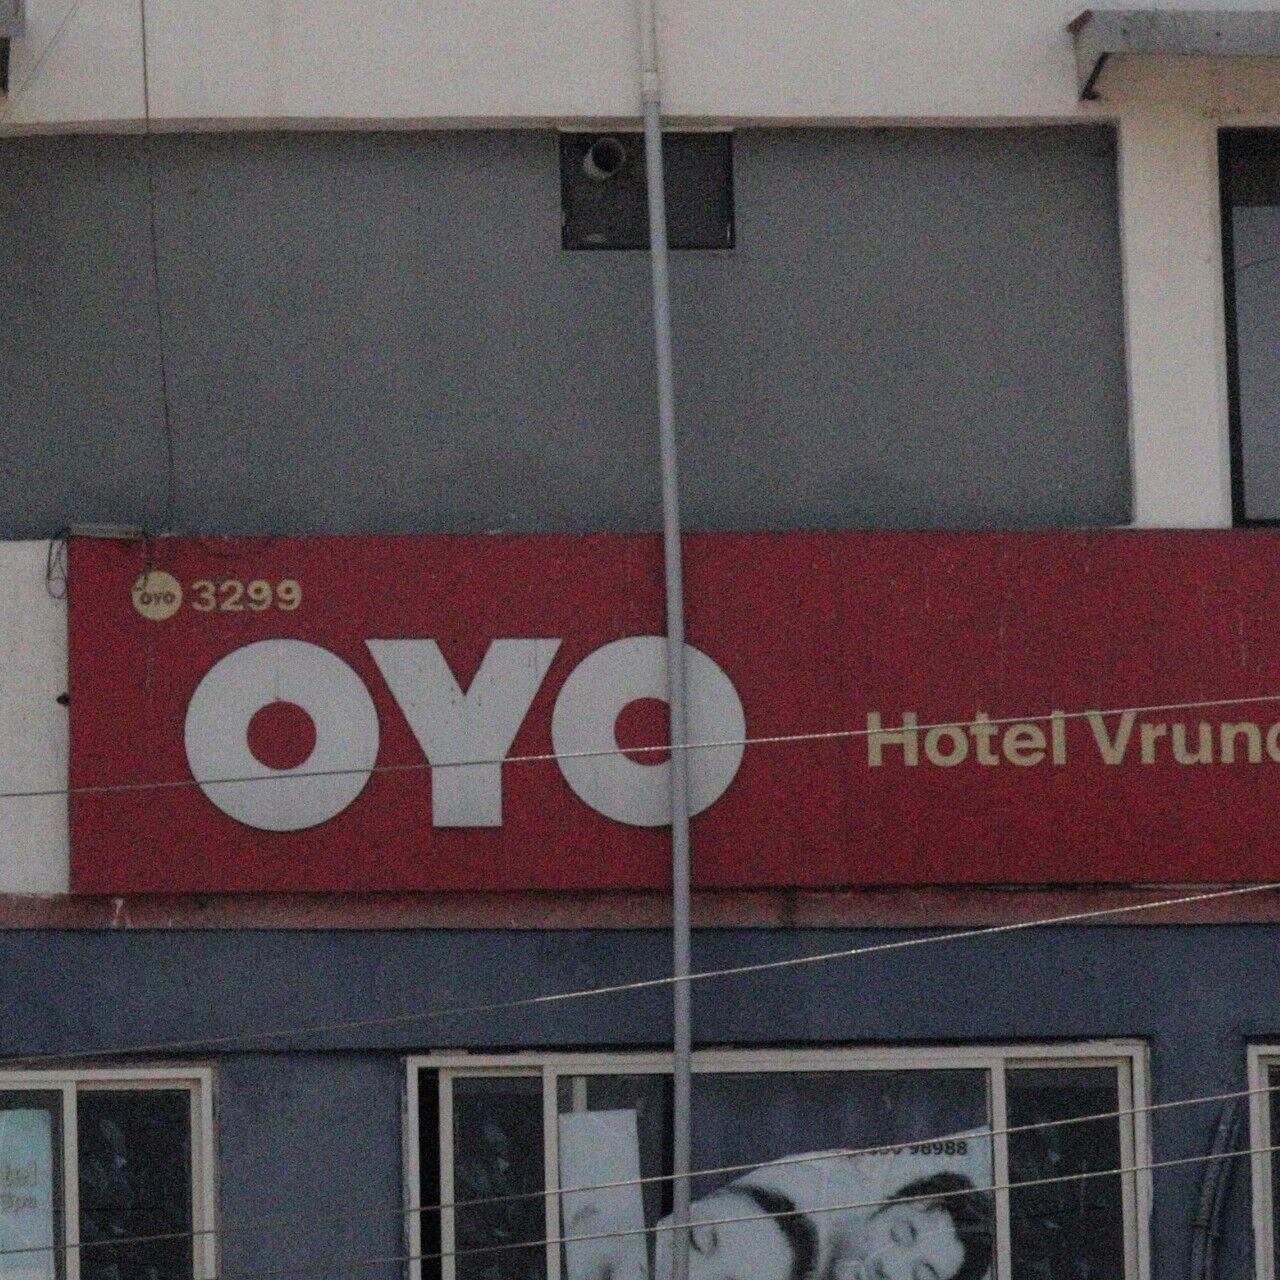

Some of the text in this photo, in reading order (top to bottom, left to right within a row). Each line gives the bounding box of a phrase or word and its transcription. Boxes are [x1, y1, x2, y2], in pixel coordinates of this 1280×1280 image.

[191, 579, 302, 612] 3299
[184, 634, 746, 832] OYO
[867, 710, 1066, 768] Hotel
